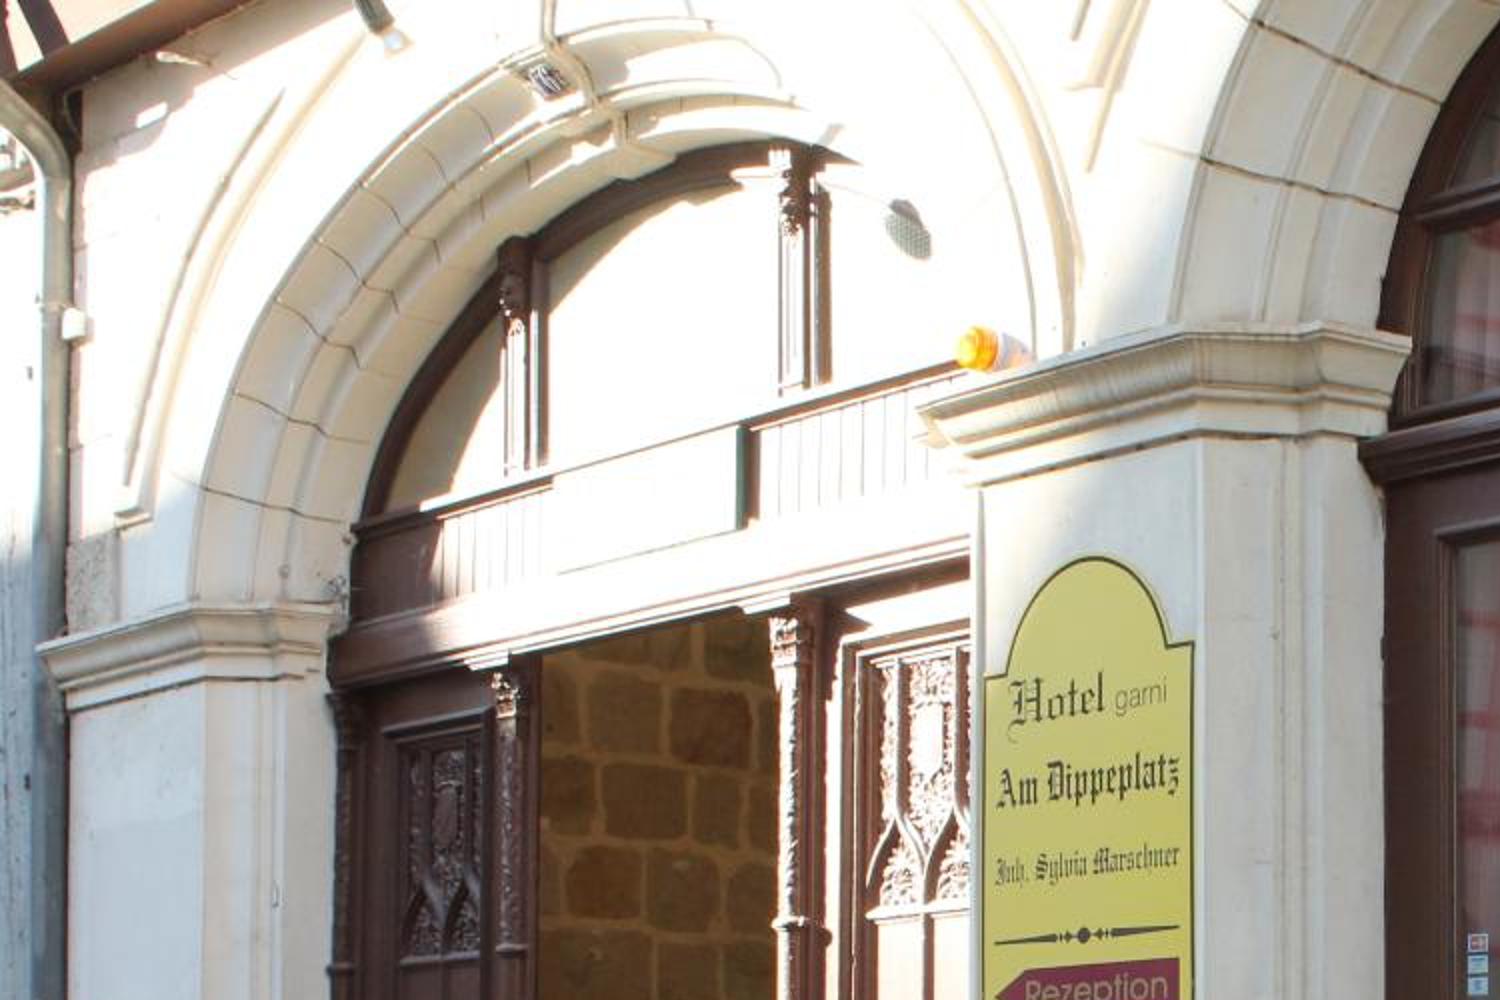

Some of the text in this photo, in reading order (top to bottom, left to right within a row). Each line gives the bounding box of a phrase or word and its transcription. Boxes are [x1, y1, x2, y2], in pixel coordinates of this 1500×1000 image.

[1007, 671, 1168, 744] Hotel garni
[995, 752, 1180, 809] Am Dippeplatz
[1035, 850, 1088, 886] Sylvia
[1093, 843, 1180, 875] Marschner
